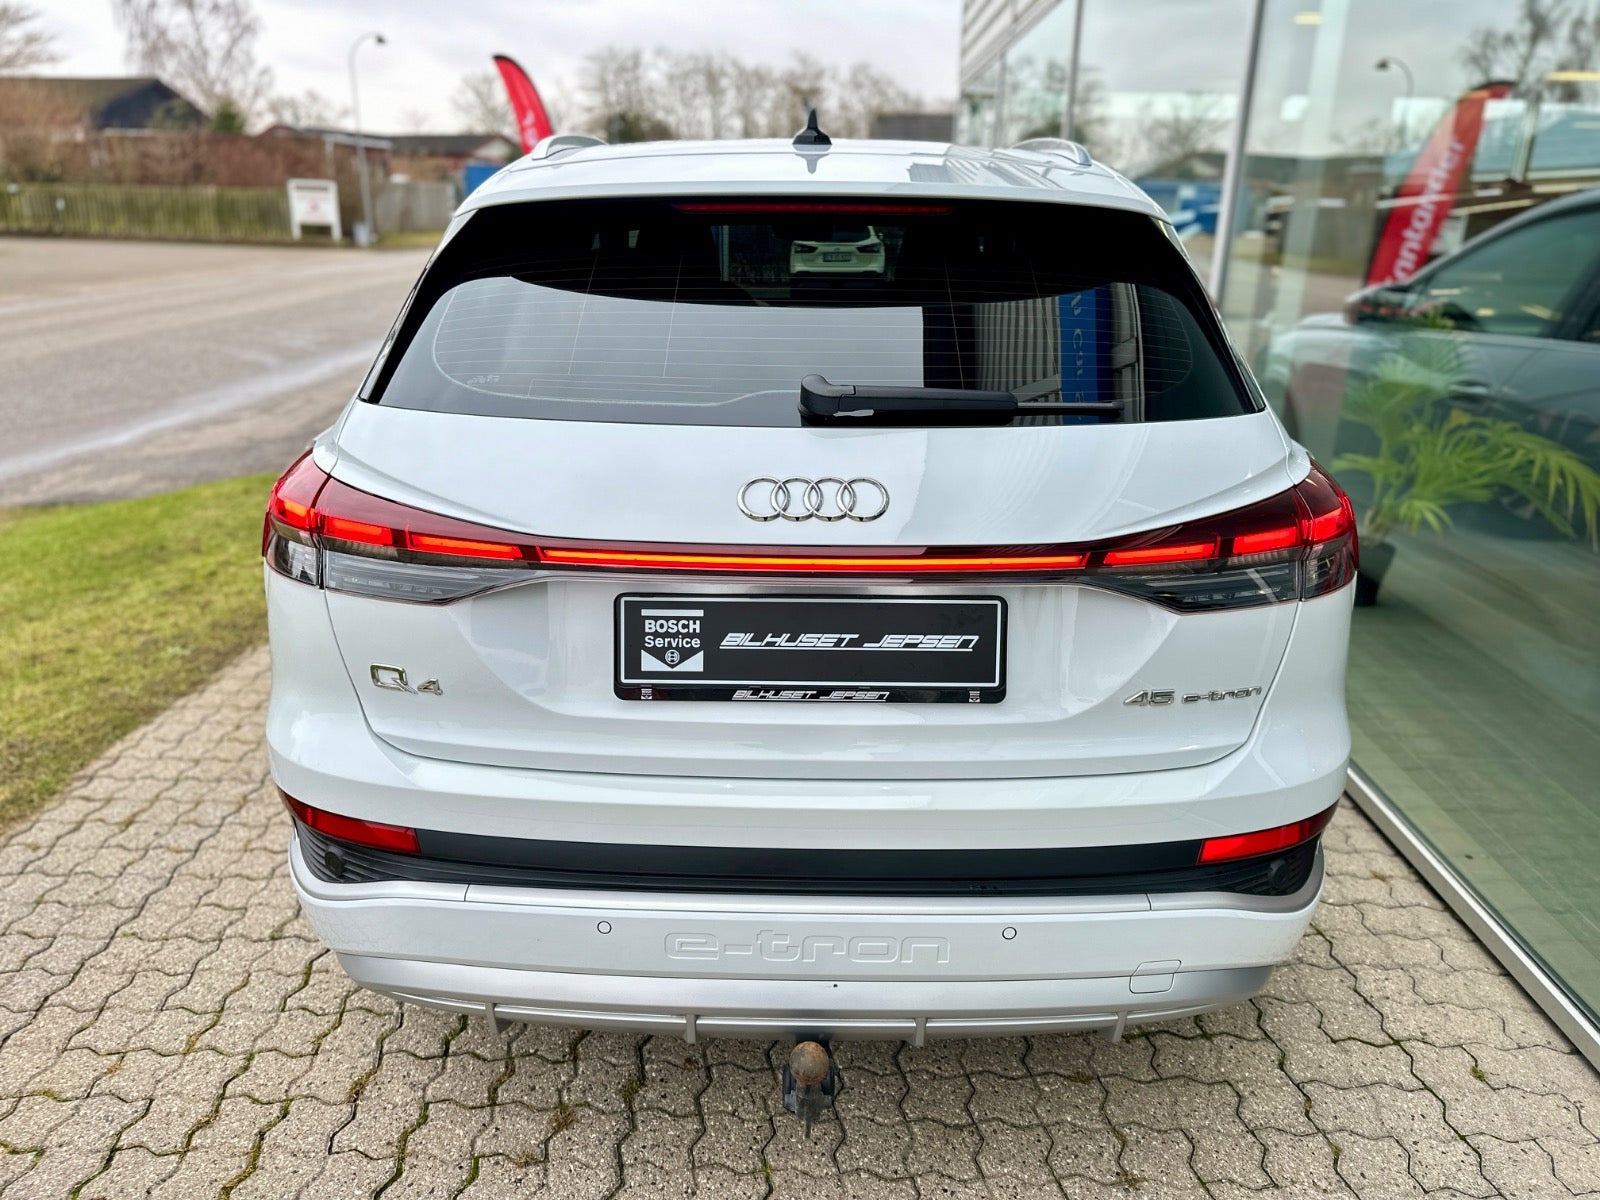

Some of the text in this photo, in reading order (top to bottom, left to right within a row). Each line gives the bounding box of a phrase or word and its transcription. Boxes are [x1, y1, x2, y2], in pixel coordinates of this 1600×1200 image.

[1384, 140, 1464, 284] antander
[644, 620, 700, 634] BOSCH
[644, 635, 702, 649] Service
[720, 632, 980, 649] BILHUSET JEPSEN
[370, 664, 443, 695] Q4
[732, 690, 889, 702] BILHUSET JEPSEN
[1123, 685, 1262, 706] 45 e-tron
[664, 929, 951, 963] e-tron
